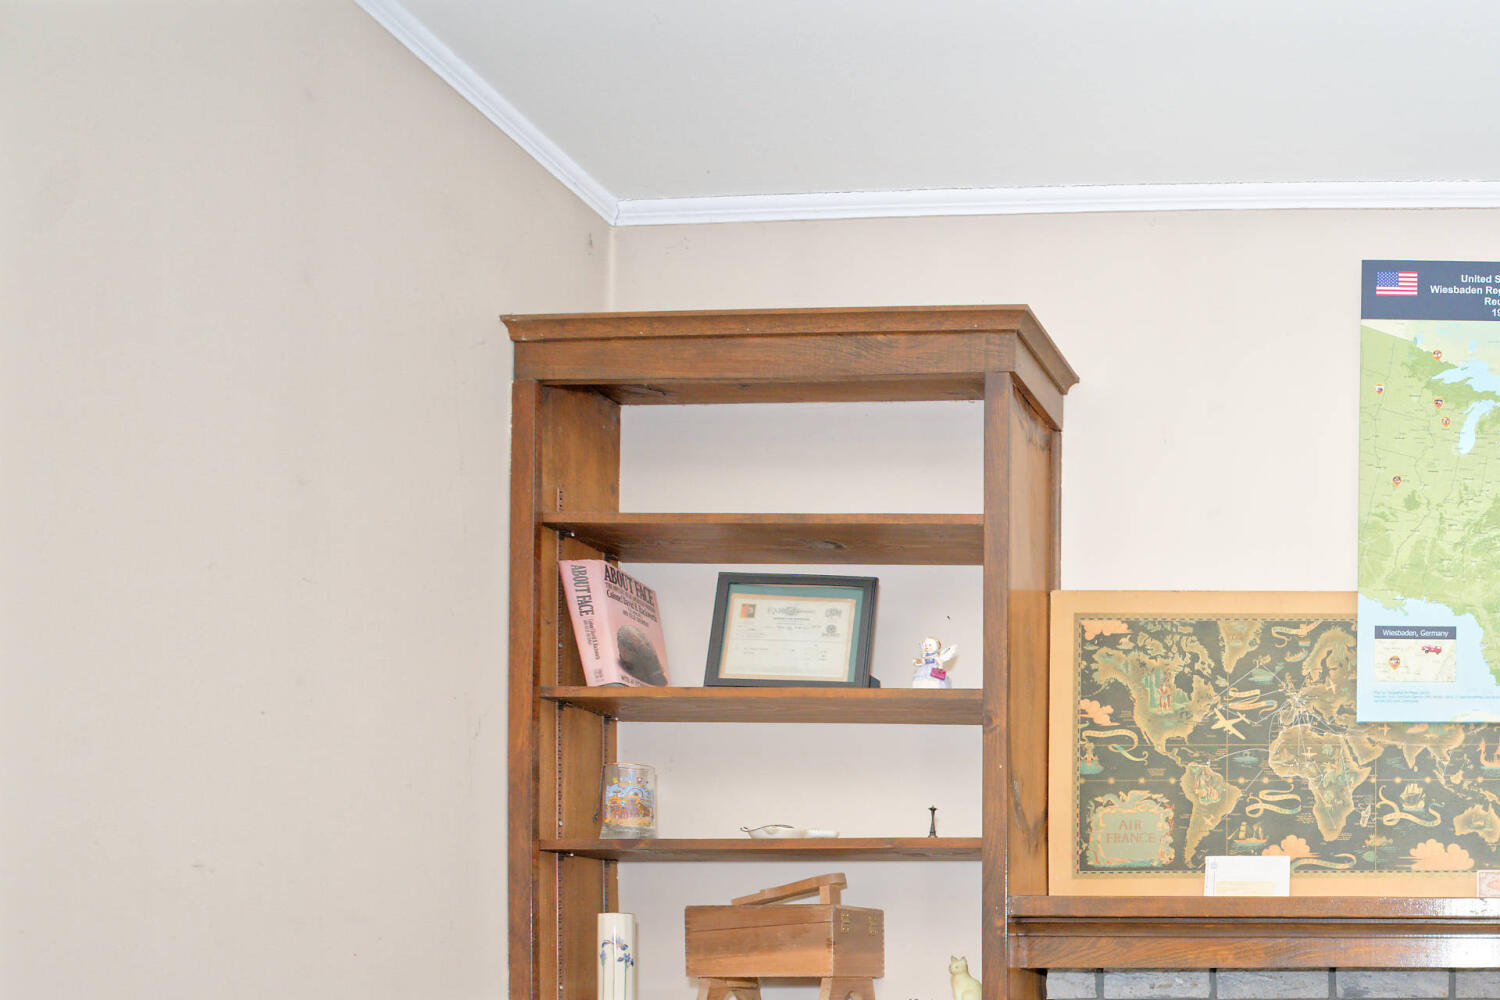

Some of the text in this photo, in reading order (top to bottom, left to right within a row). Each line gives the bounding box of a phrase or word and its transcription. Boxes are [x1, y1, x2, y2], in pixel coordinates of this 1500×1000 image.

[1460, 274, 1492, 284] United
[1430, 285, 1483, 295] Wiesbaden
[570, 564, 592, 593] ABOUT
[604, 564, 634, 595] ABOUT
[633, 580, 655, 608] FACE
[576, 594, 595, 617] FACE
[1382, 629, 1449, 638] Wiesbaden, Germany
[1119, 820, 1142, 831] AIR
[1105, 832, 1157, 844] FRANCE
